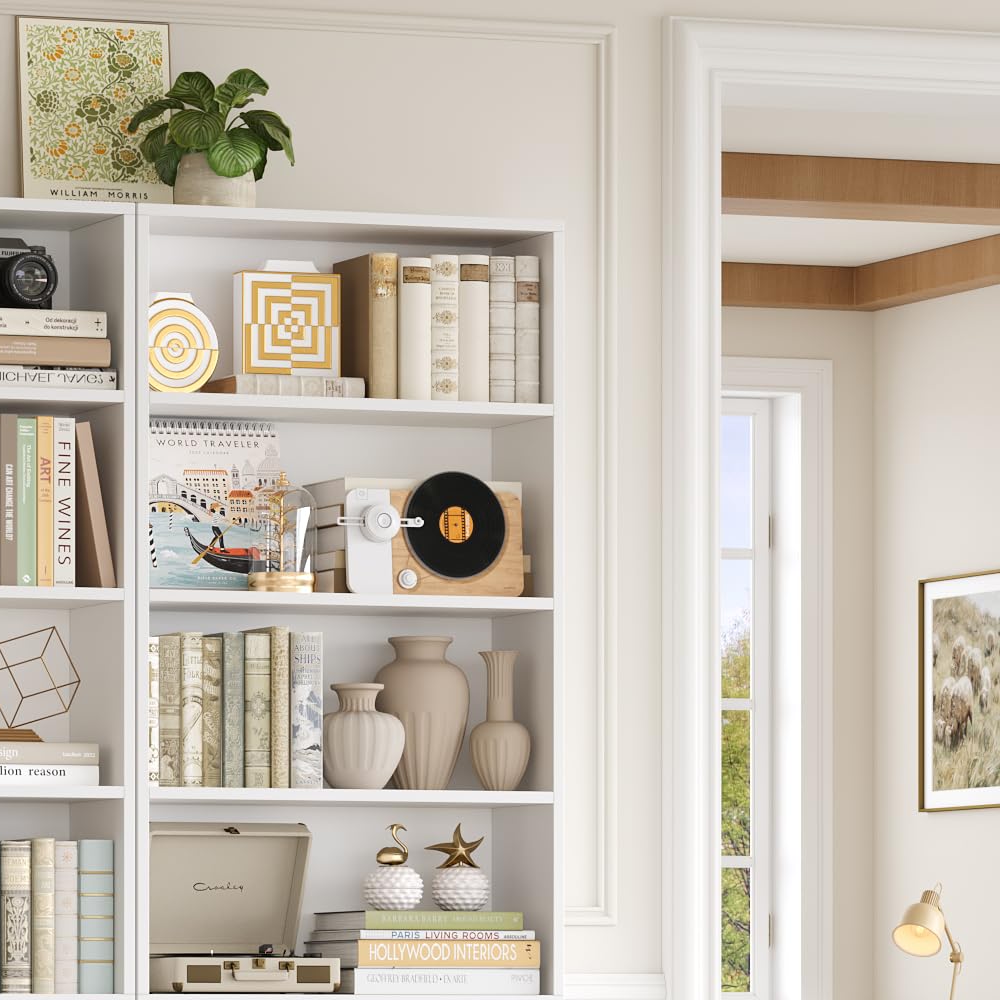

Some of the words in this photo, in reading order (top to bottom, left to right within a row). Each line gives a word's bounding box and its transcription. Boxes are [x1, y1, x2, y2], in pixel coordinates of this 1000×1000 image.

[50, 189, 98, 198] WILLIAM
[108, 191, 149, 200] MORRIS
[54, 317, 77, 325] dekoracji
[156, 439, 198, 447] WORLD
[203, 440, 259, 448] TRAVELER
[58, 442, 71, 487] FINE
[39, 457, 51, 484] ART
[58, 497, 71, 565] WINES
[294, 654, 321, 665] SHIPS
[29, 768, 66, 777] reason
[391, 931, 420, 939] PARIS
[425, 931, 458, 939] LIVING
[462, 932, 500, 940] ROOMS
[369, 943, 450, 961] HOLLYWOOD
[453, 943, 517, 961] INTERIORS
